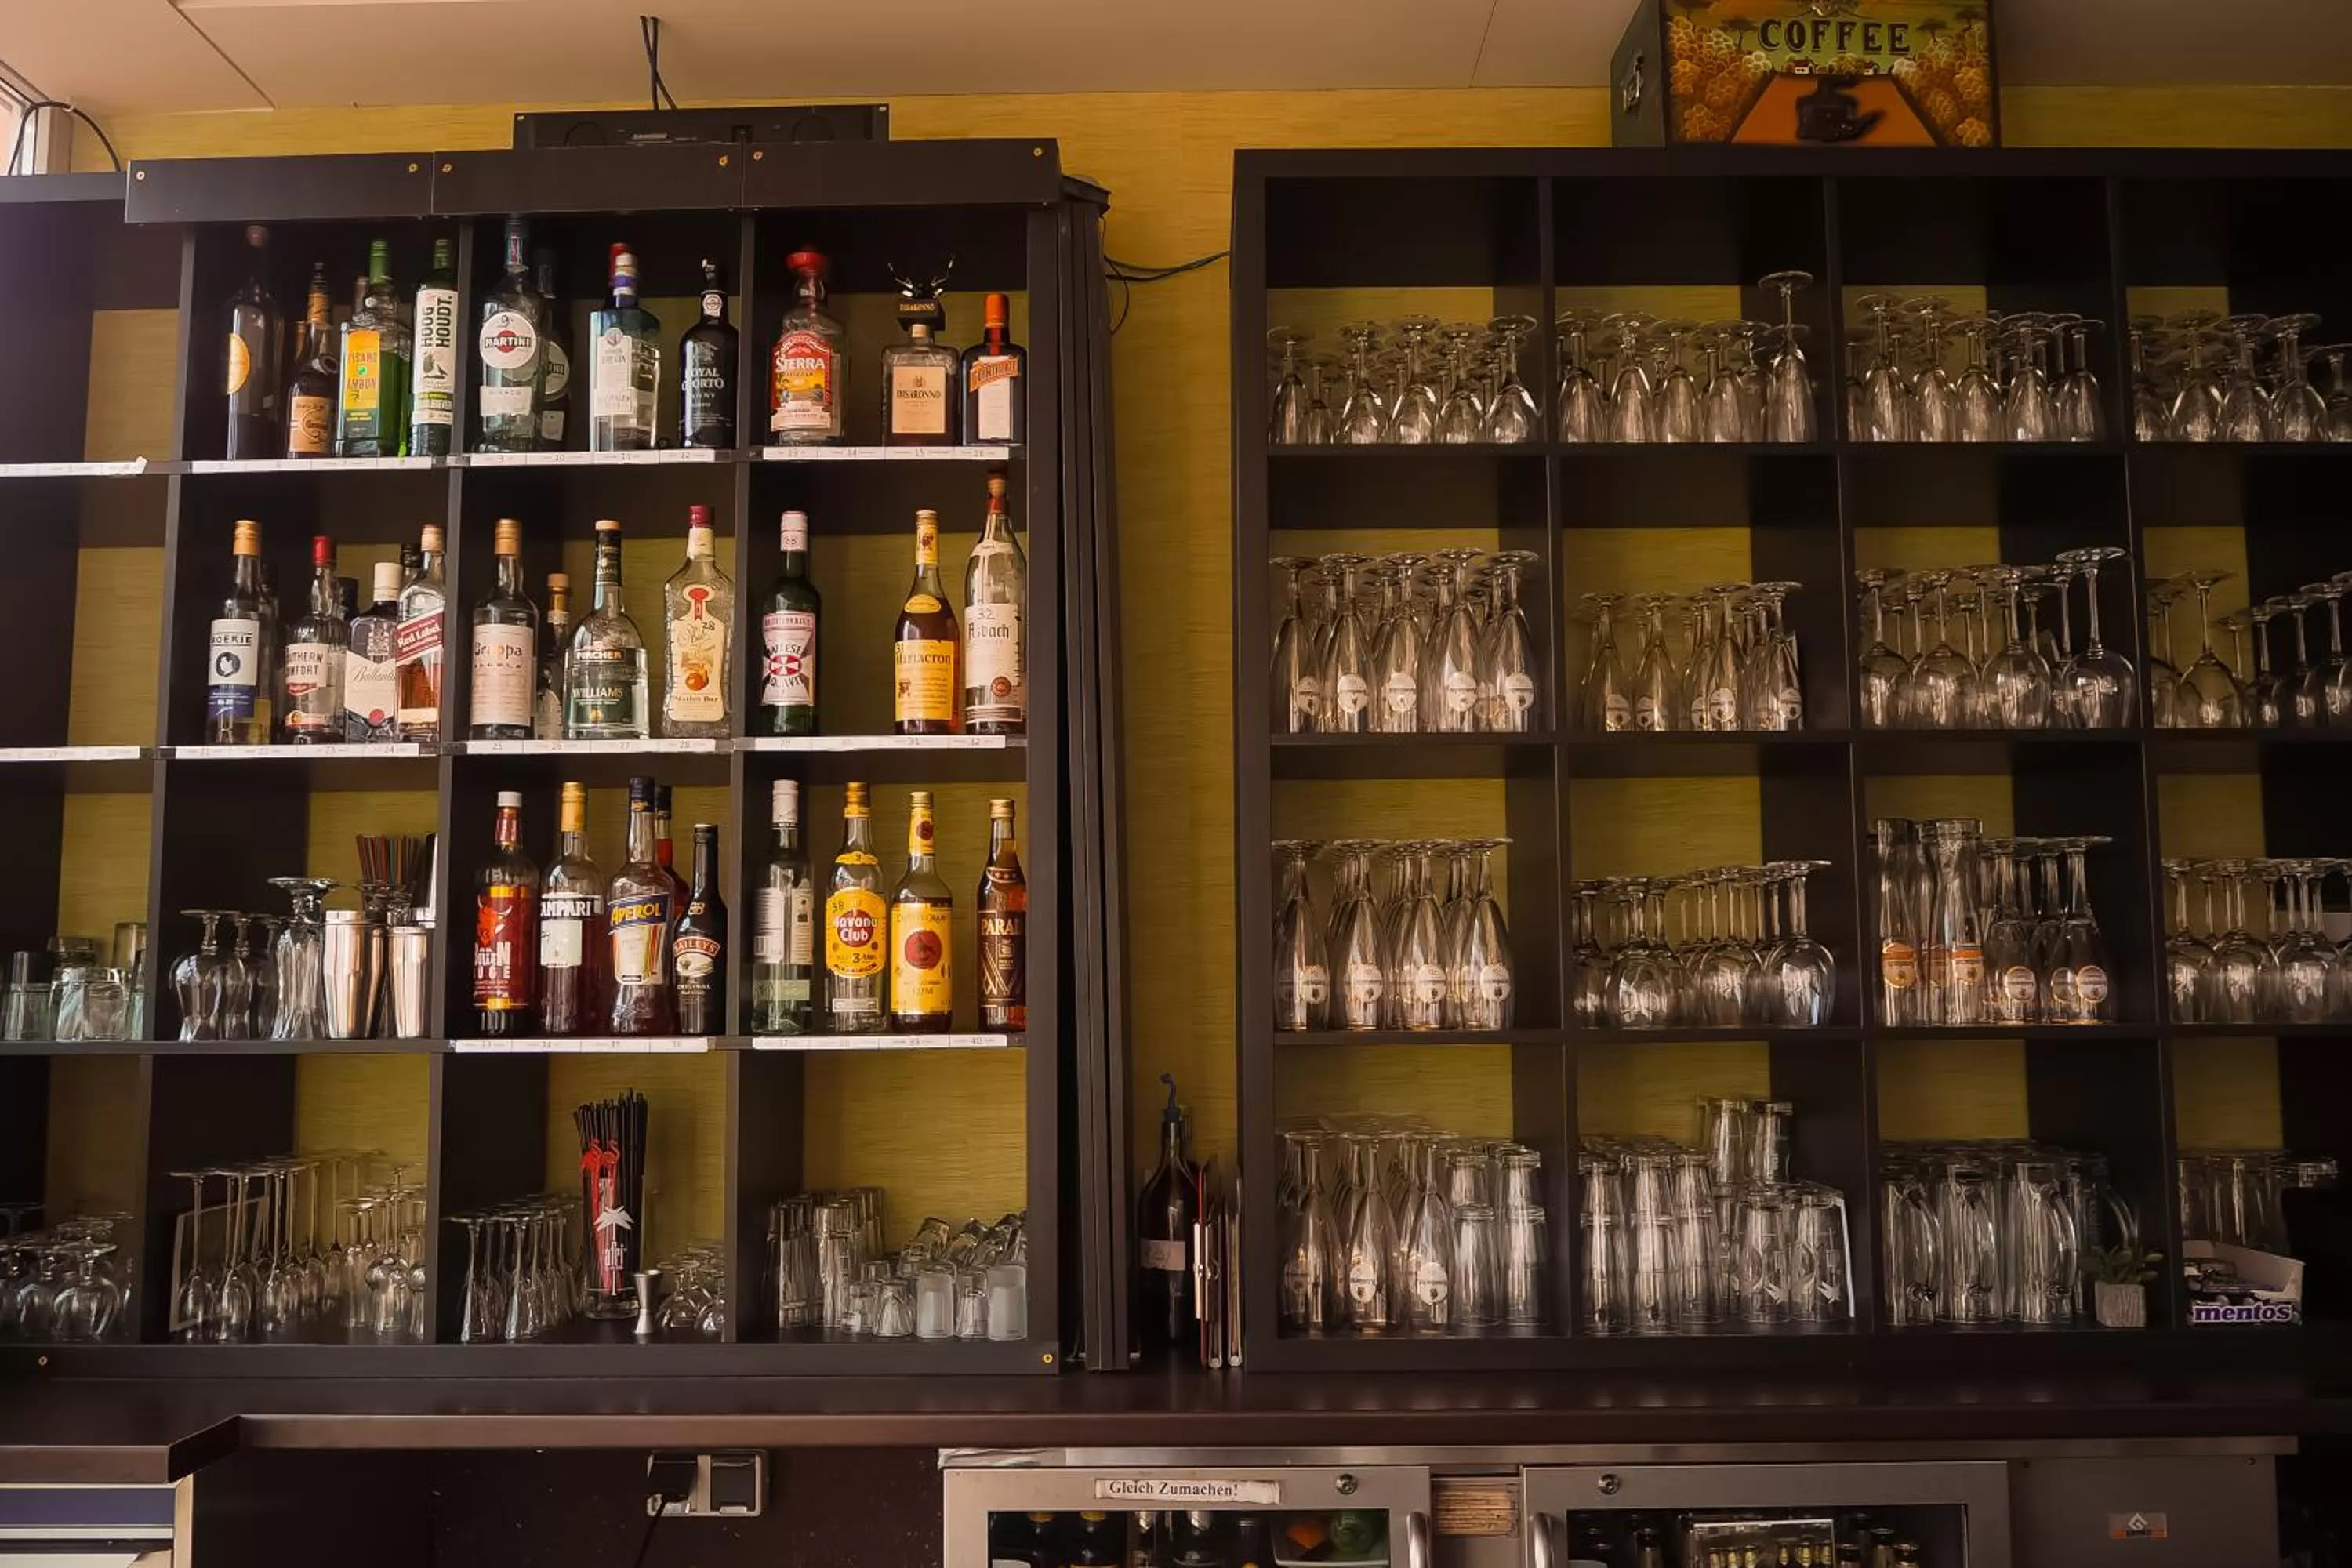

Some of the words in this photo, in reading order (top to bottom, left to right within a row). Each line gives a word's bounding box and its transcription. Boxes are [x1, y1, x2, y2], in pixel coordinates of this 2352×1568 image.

[1758, 18, 1911, 53] COFFEE
[485, 336, 531, 349] MARTINI
[775, 355, 826, 372] SIERRA
[686, 367, 720, 377] OYAL
[397, 634, 416, 648] Red
[416, 623, 440, 641] Label
[573, 687, 624, 699] WILLIAMS
[539, 900, 592, 916] AMPARI
[611, 902, 660, 925] APEROL
[840, 928, 869, 942] Club
[674, 938, 717, 953] BAILEYS
[2194, 1303, 2292, 1323] mentos
[1109, 1480, 1153, 1494] Gleich
[1158, 1481, 1239, 1497] Zumachen!
